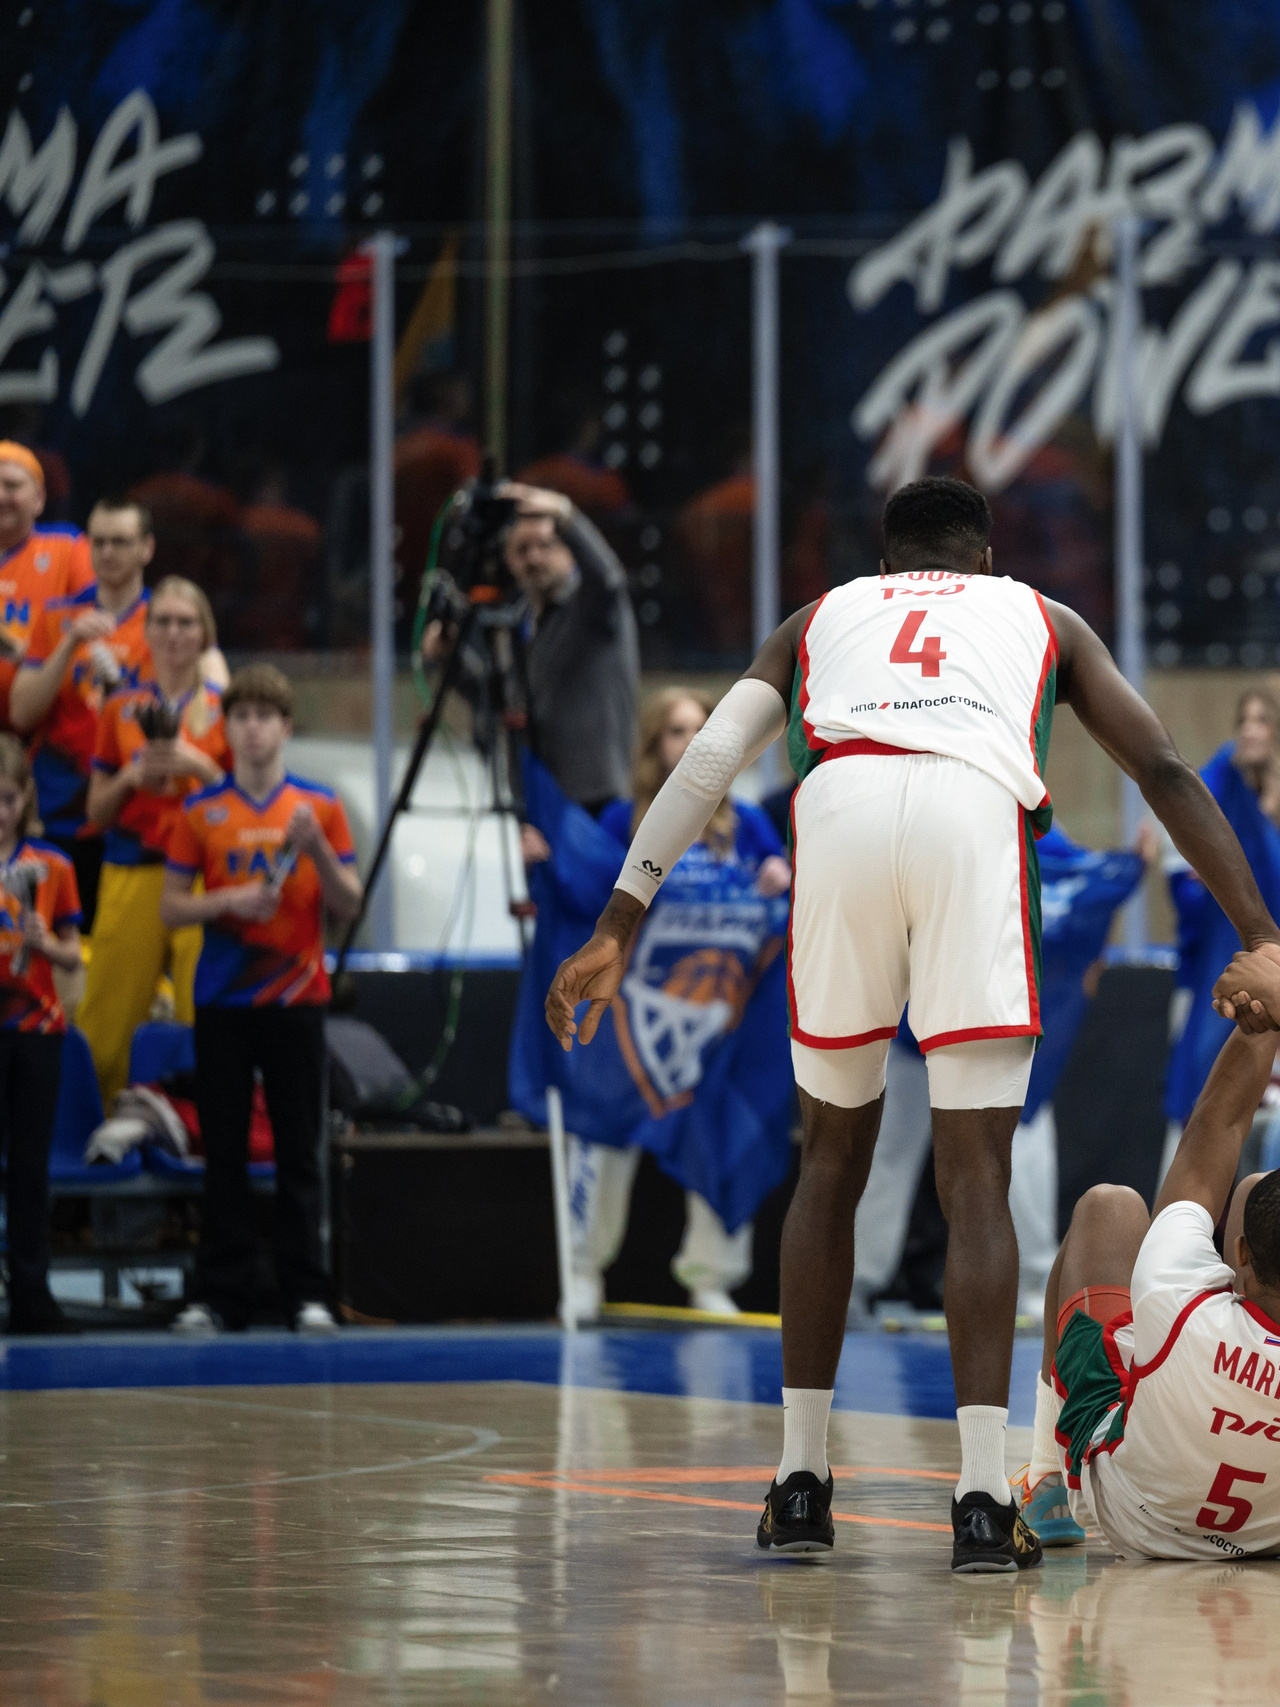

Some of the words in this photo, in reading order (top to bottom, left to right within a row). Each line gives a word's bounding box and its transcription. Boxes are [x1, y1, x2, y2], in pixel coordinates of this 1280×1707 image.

[0, 217, 282, 420] ER
[889, 610, 947, 678] 4
[850, 702, 877, 714] НПФ
[1195, 1462, 1267, 1533] 5
